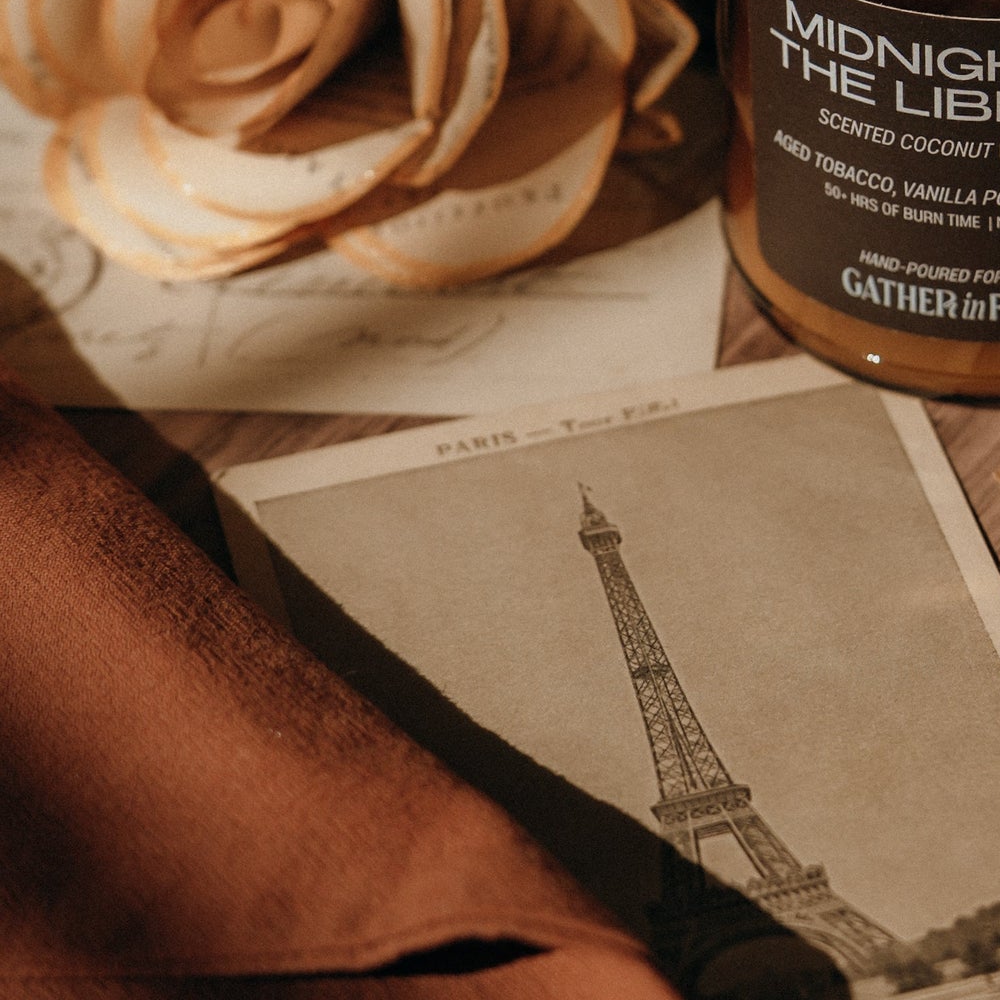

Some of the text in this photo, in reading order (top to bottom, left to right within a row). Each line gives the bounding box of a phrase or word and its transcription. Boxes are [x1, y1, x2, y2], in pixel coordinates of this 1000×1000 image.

[770, 27, 876, 106] THE
[818, 108, 896, 146] SCENTED
[900, 133, 994, 158] COCONUT
[773, 129, 811, 162] AGED
[815, 151, 897, 197] TOBACCO,
[903, 180, 977, 205] VANILLA
[850, 191, 879, 212] HRS
[881, 201, 900, 217] OF
[903, 206, 944, 226] BURN
[947, 212, 981, 229] TIME
[859, 250, 971, 283] HAND-POURED
[841, 266, 958, 320] GATHER
[961, 291, 985, 321] in
[436, 429, 517, 456] PARIS
